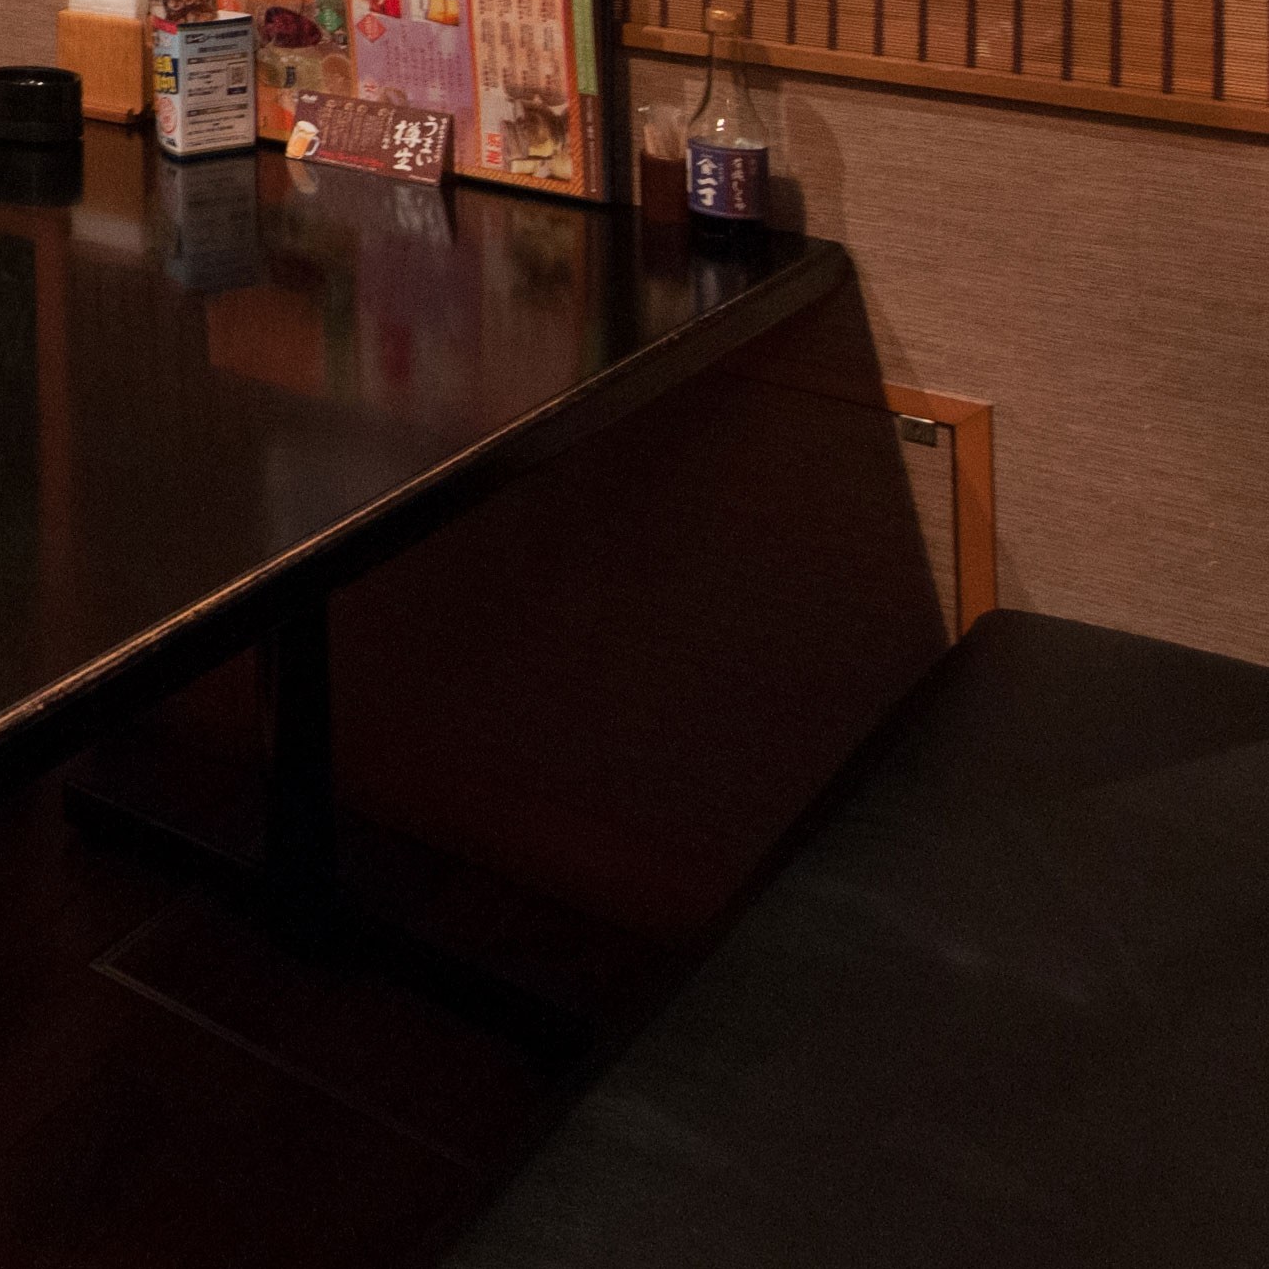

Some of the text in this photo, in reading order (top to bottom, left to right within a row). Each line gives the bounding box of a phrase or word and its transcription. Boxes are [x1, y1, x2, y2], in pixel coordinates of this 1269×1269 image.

[393, 120, 422, 171] 樽生
[415, 115, 438, 167] うまい
